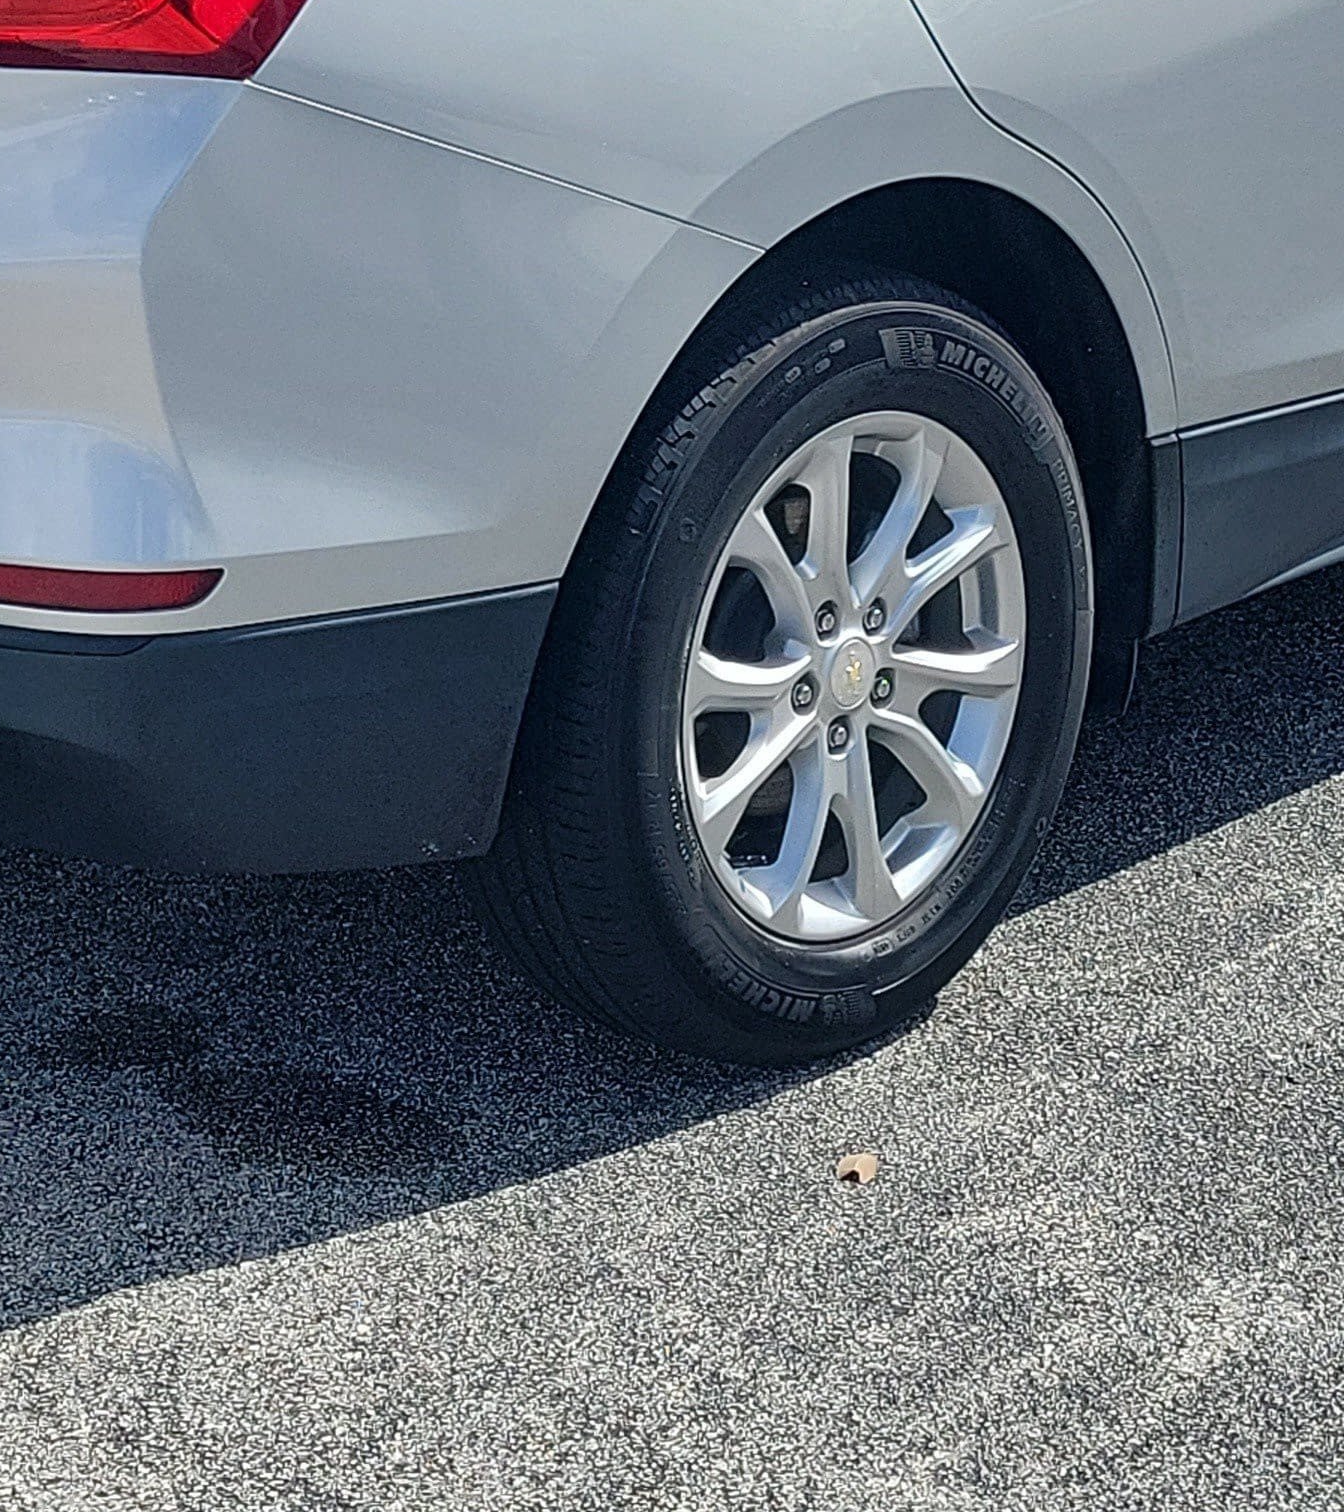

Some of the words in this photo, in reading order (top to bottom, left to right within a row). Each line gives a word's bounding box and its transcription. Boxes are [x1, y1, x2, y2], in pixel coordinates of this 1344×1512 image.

[940, 340, 1053, 444] MICHELIN
[1052, 458, 1084, 550] PRIMACY
[698, 940, 817, 1023] MICHE
